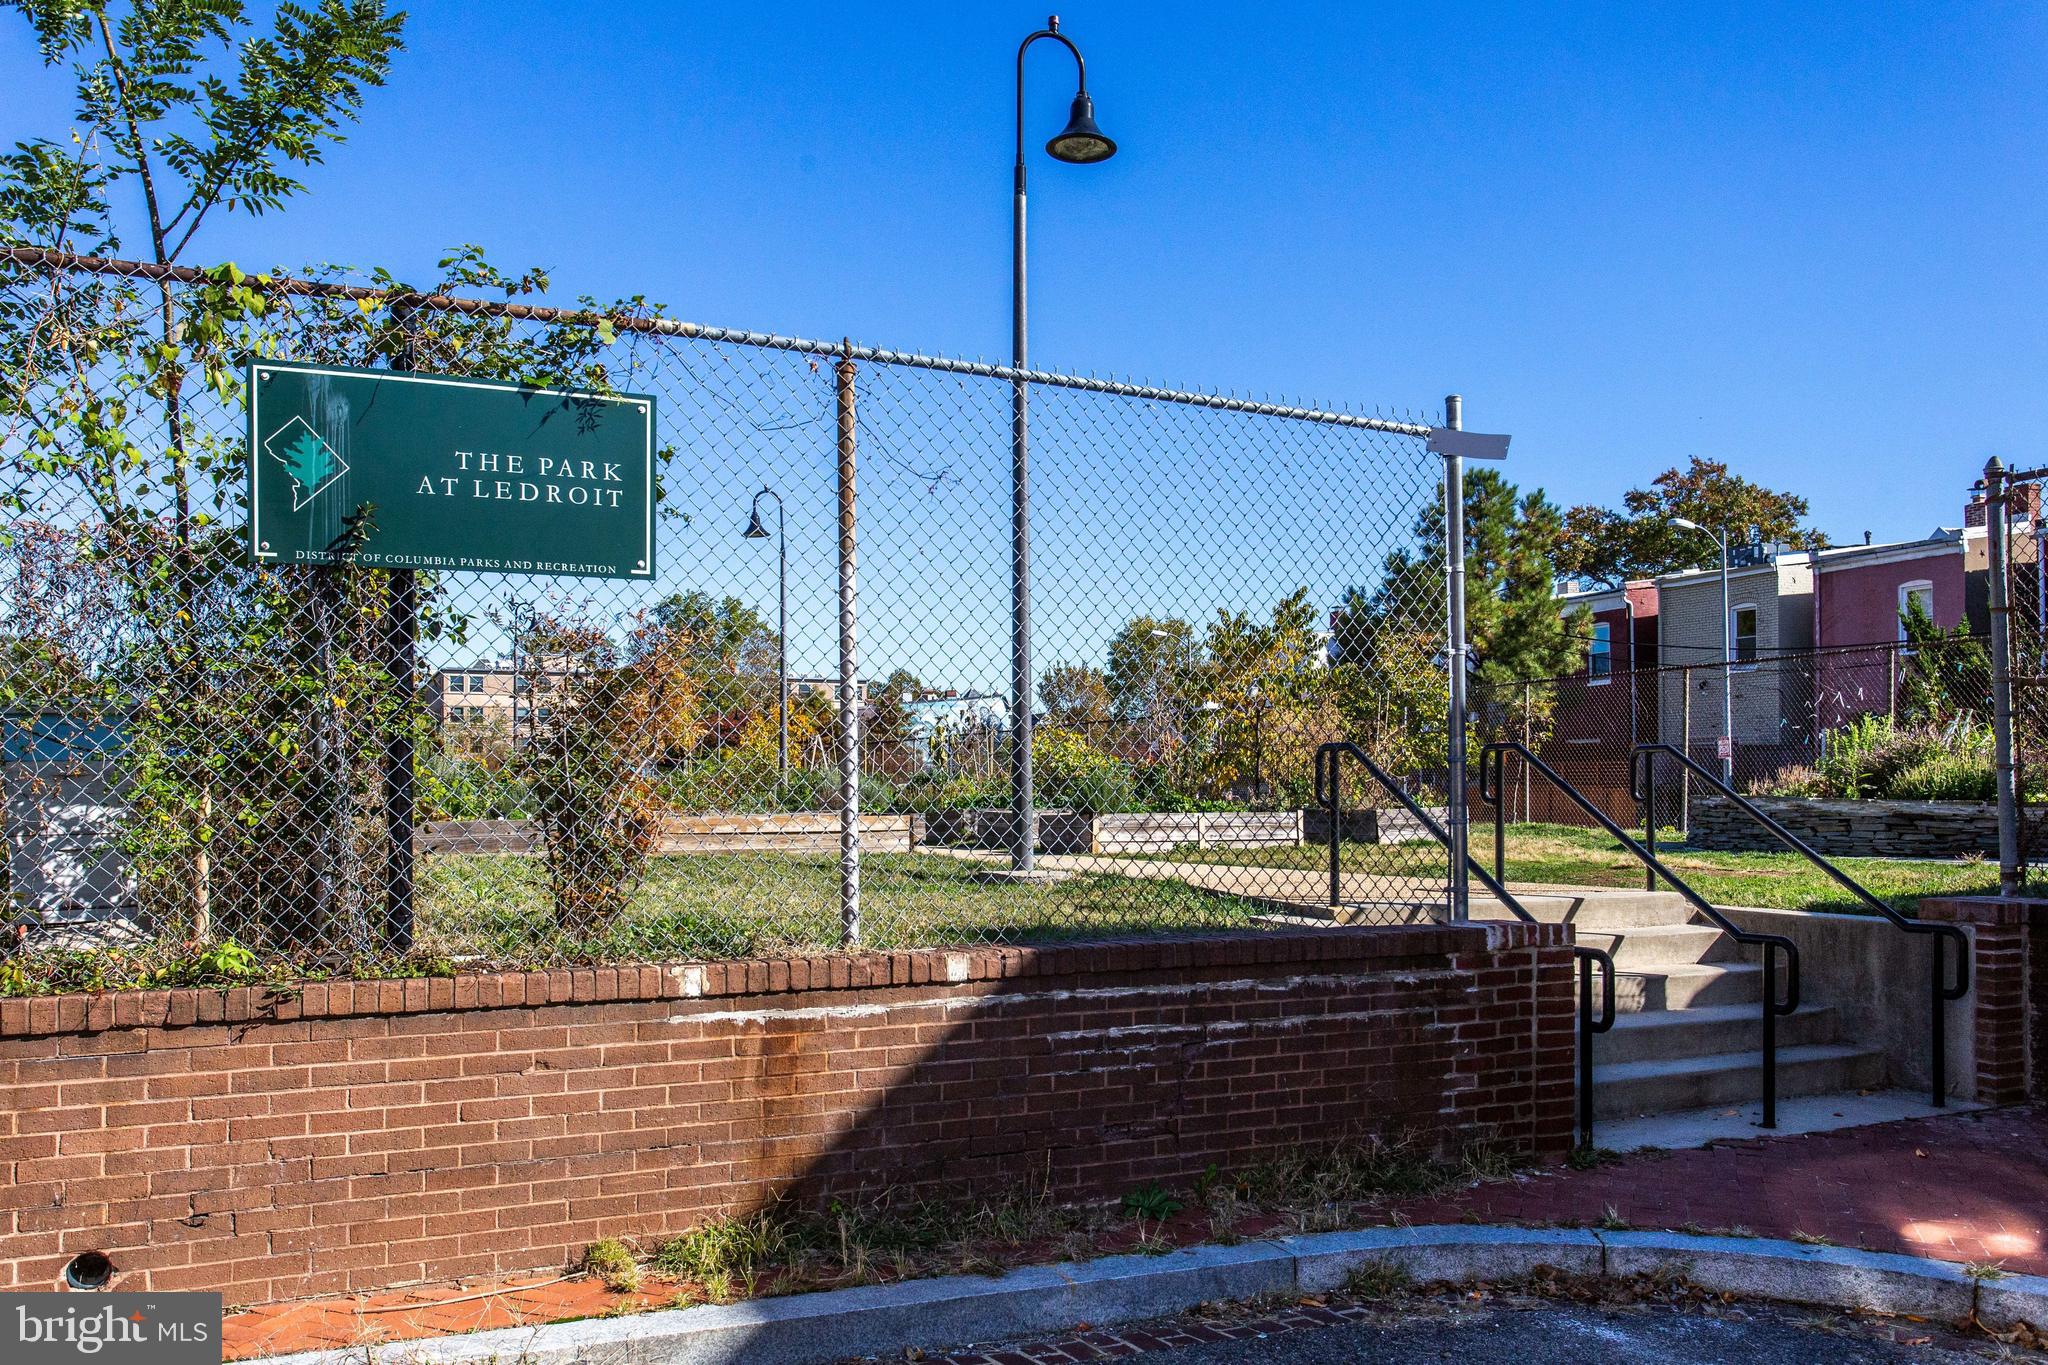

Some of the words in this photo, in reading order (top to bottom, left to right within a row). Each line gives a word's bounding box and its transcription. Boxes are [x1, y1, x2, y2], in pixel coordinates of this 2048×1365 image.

[455, 451, 524, 474] THE
[538, 457, 623, 481] PARK
[416, 475, 459, 497] AT
[473, 479, 623, 508] LEDROIT
[363, 553, 382, 562] OF
[385, 554, 456, 566] COLUMBIA
[460, 557, 500, 568] PARKS
[504, 560, 532, 570] AND
[536, 561, 617, 574] RECREATION
